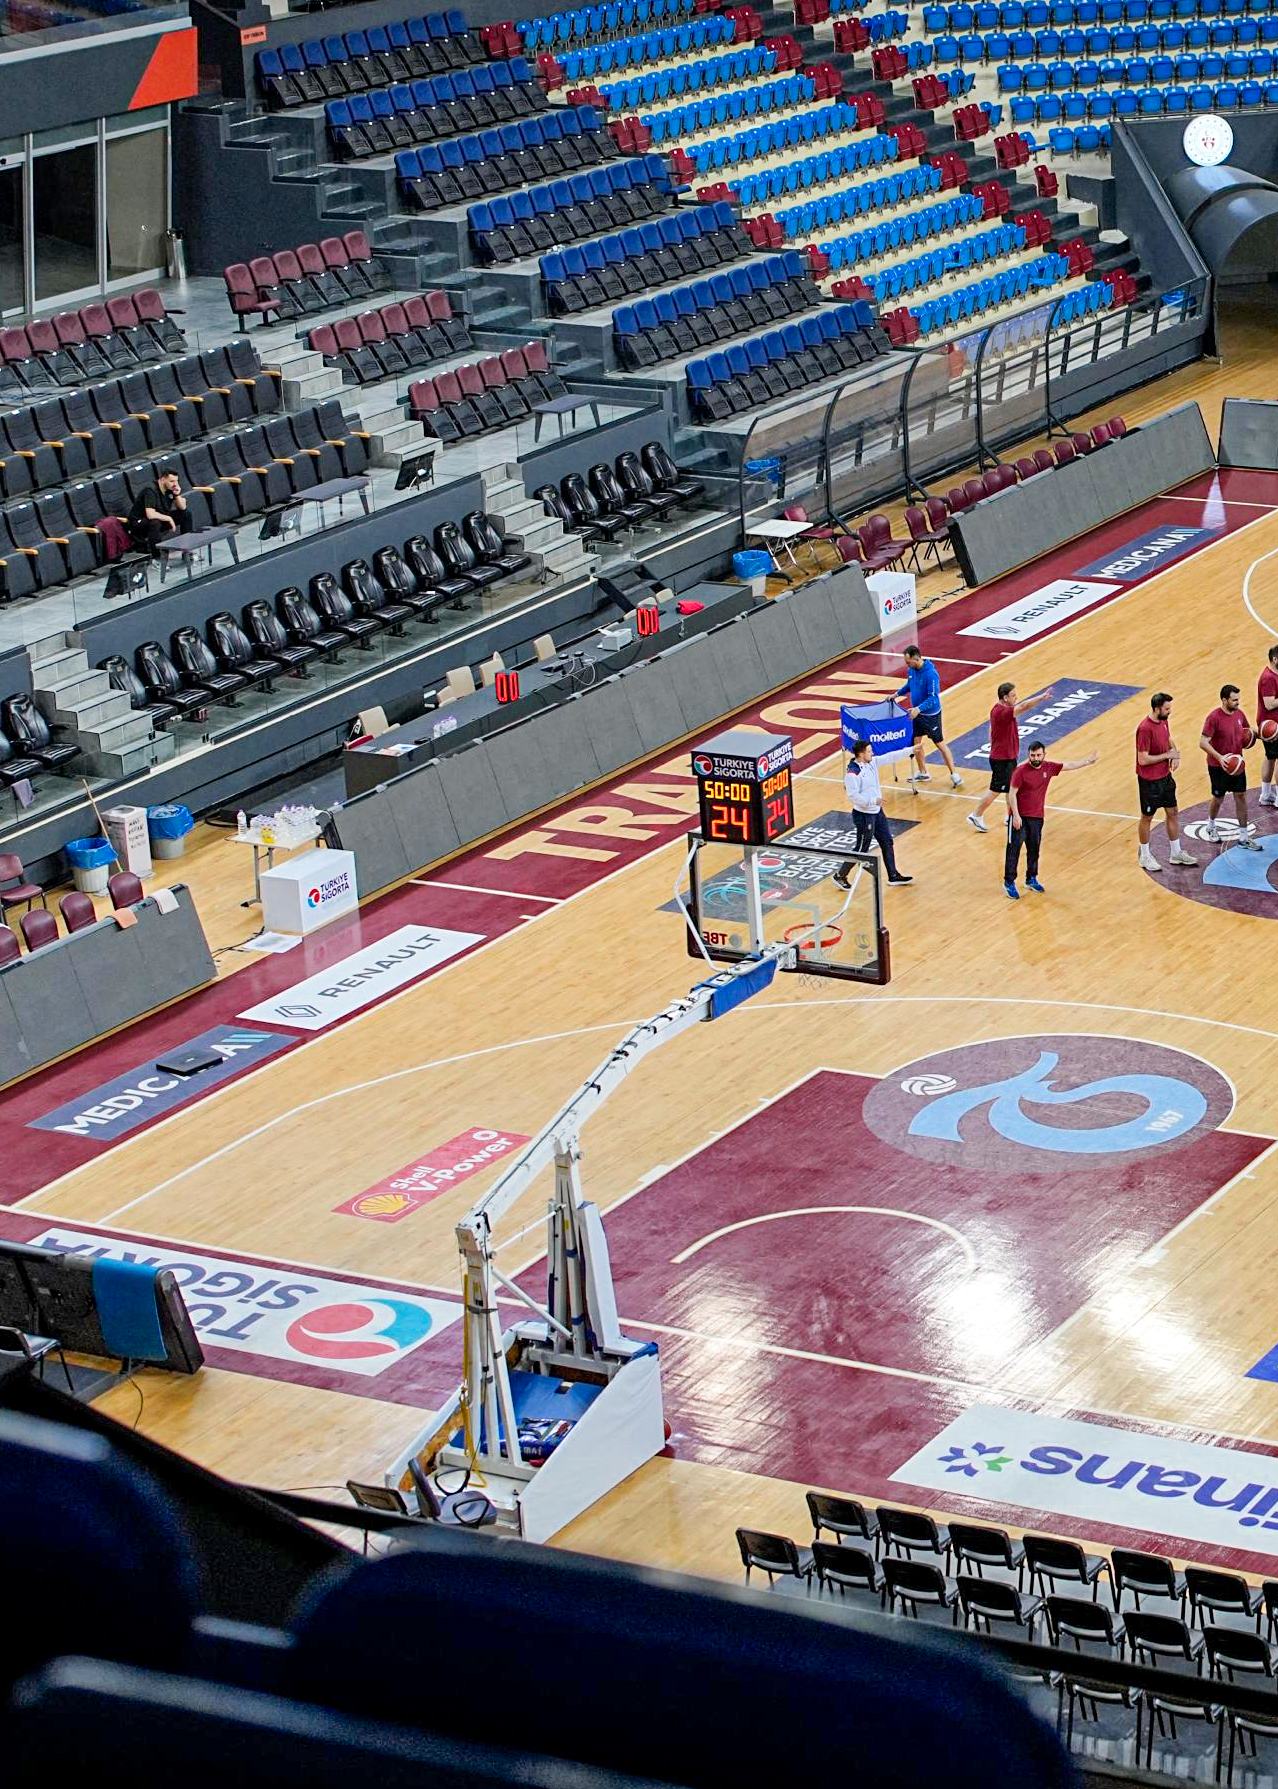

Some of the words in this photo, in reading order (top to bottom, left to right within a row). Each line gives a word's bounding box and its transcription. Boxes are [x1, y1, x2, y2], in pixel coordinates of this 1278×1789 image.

[1012, 584, 1090, 624] RENAULT
[495, 672, 519, 703] 00
[1025, 688, 1101, 725] BANK
[870, 729, 906, 742] molten
[705, 781, 750, 802] 50:00
[762, 768, 789, 799] 50:00
[711, 806, 748, 840] 24
[767, 794, 789, 837] 24
[319, 933, 443, 998] RENAULT
[54, 1043, 253, 1135] MEDICA
[389, 1166, 436, 1190] Shell
[407, 1137, 514, 1193] V-Power
